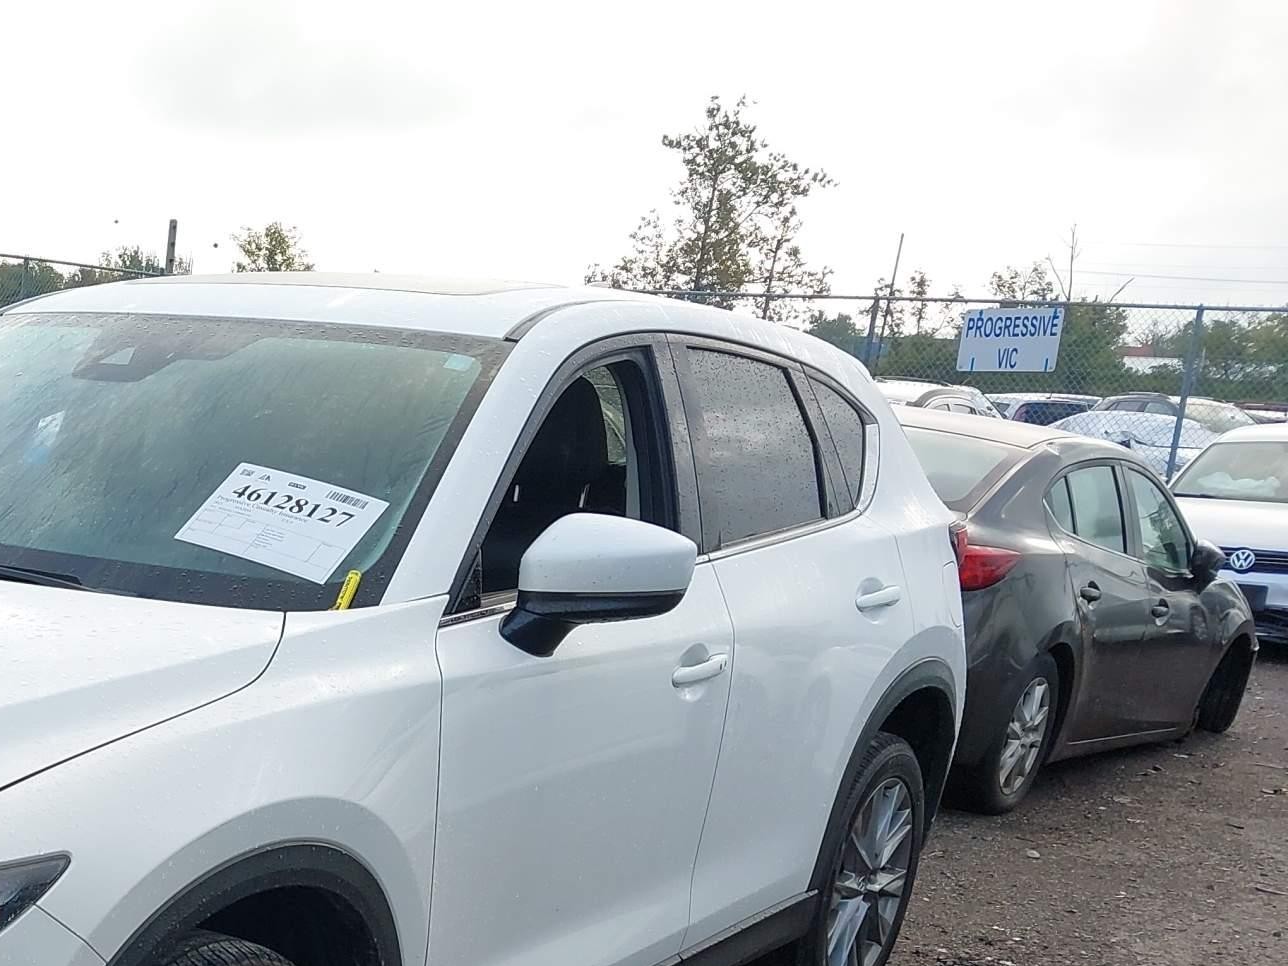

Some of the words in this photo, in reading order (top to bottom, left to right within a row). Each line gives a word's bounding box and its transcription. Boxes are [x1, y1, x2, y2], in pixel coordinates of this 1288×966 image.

[966, 315, 1059, 338] PROGRESSIVE
[998, 347, 1018, 369] VIC
[232, 484, 355, 527] 46128127
